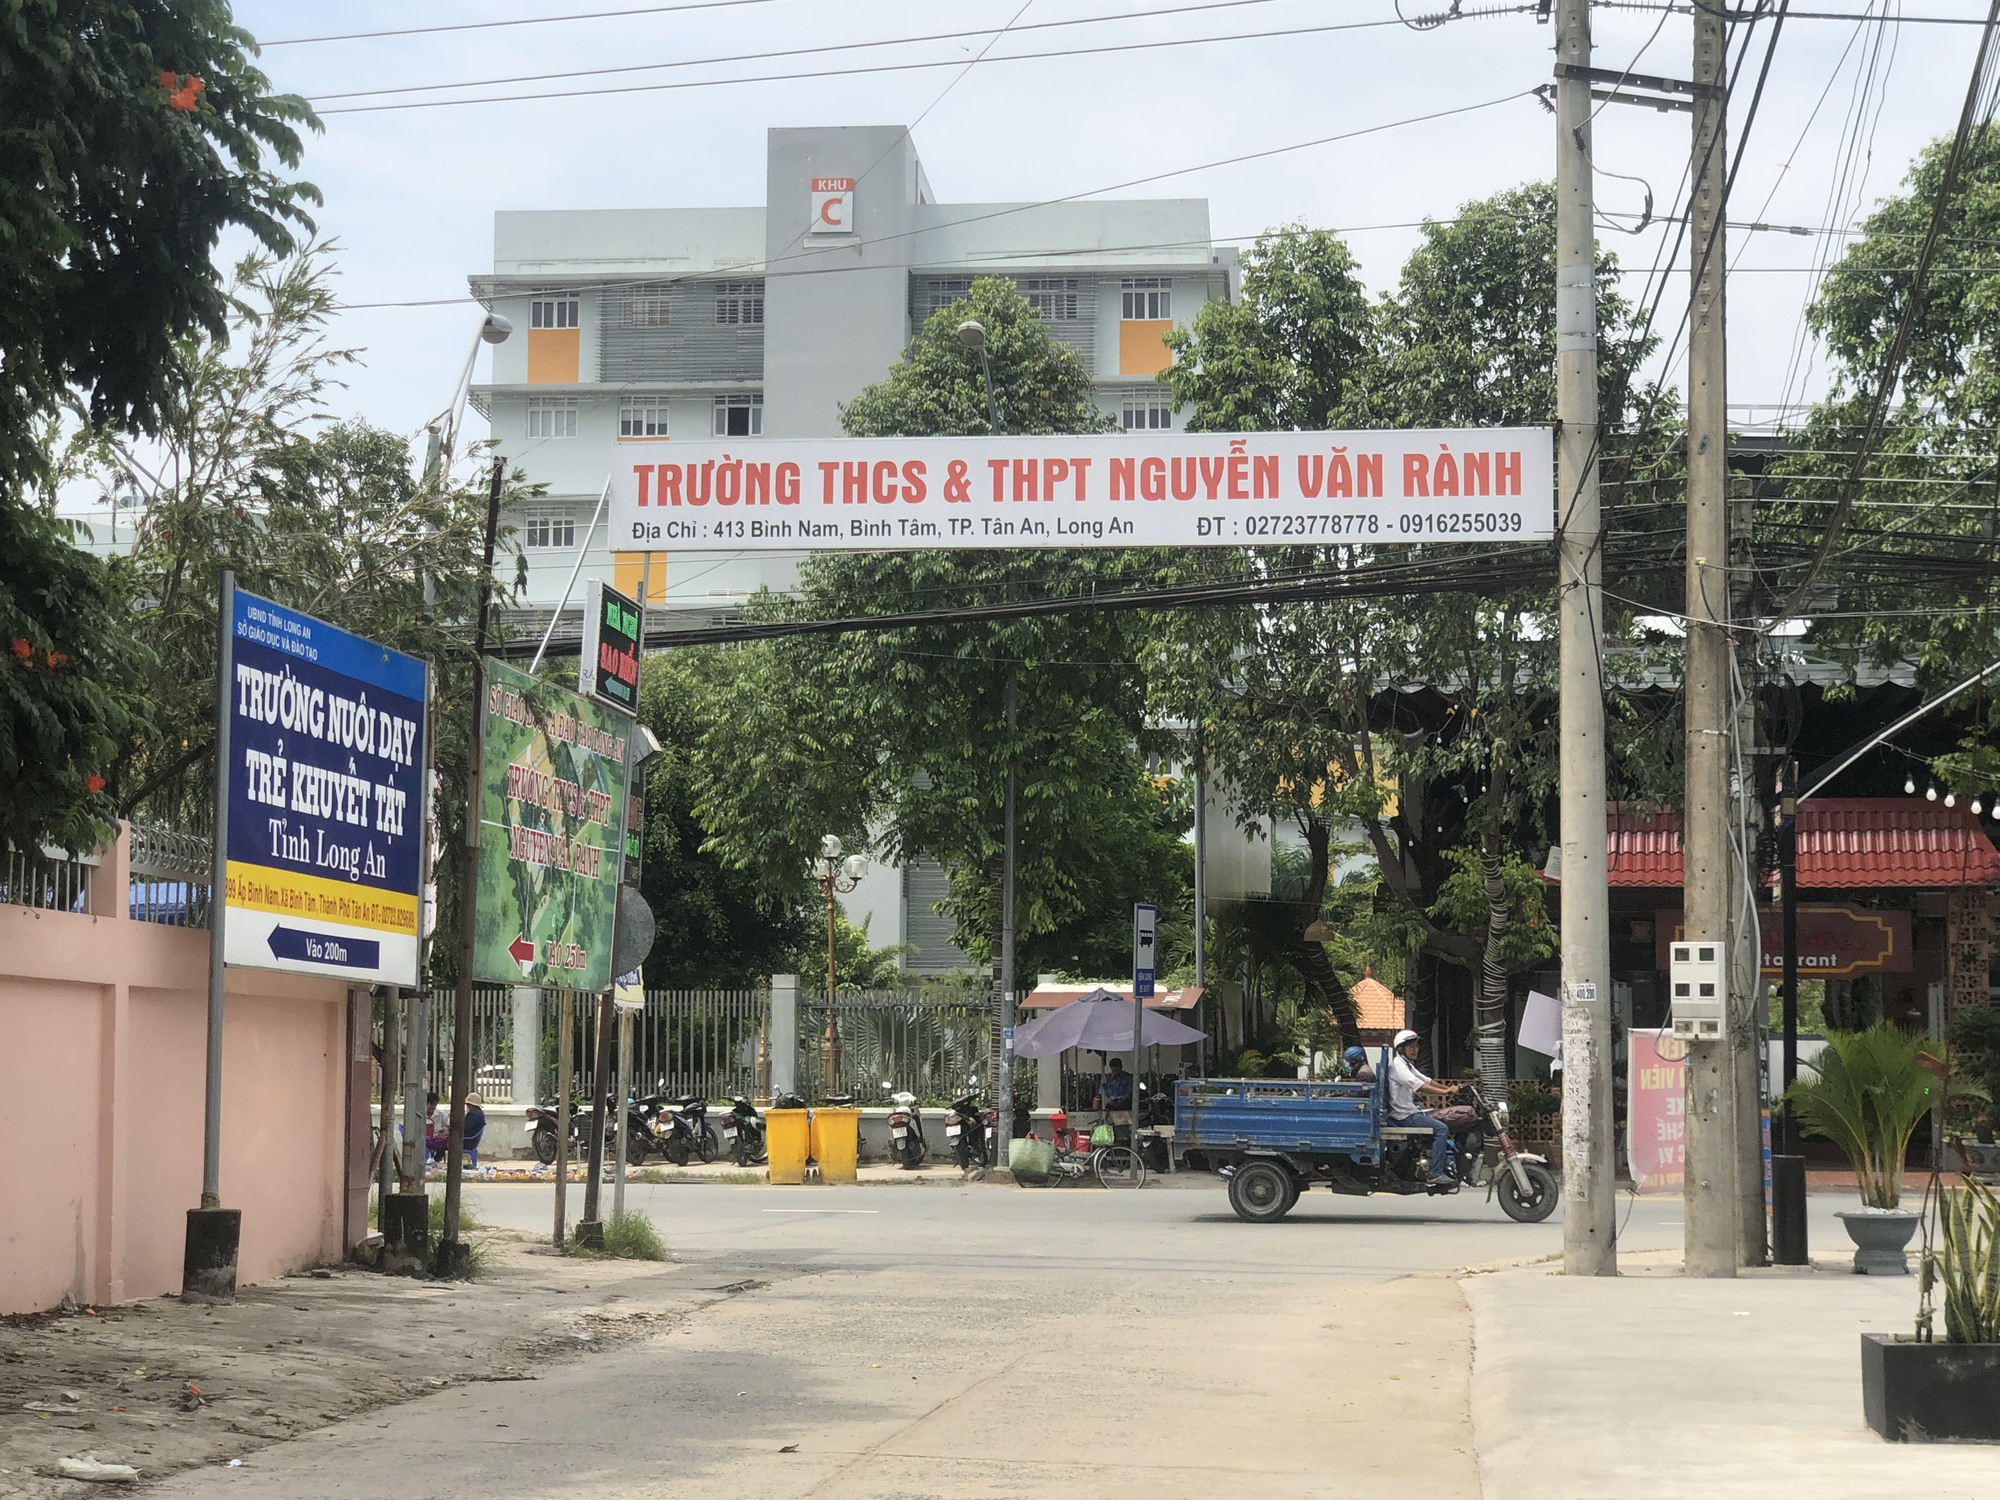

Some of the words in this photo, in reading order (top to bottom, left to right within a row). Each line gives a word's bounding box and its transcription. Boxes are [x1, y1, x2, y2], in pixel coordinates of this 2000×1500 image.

[818, 179, 847, 191] KHU
[821, 198, 843, 226] C
[633, 454, 800, 507] TRƯỜNG
[818, 460, 927, 505] THCS
[943, 459, 972, 503] &
[987, 457, 1092, 502] THPT
[1109, 439, 1280, 501] NGUYỄN
[1297, 445, 1384, 498] VĂN
[1403, 443, 1522, 497] RÀNH
[632, 522, 660, 543] Địa
[667, 520, 697, 538] Chỉ
[714, 520, 745, 538] 413
[751, 520, 791, 538] Bình
[799, 520, 844, 540] Nam,
[850, 519, 891, 537] Bình
[898, 518, 942, 539] Tâm,
[948, 518, 974, 536] TP.
[981, 517, 1014, 536] Tân
[1019, 517, 1050, 538] An,
[1057, 517, 1103, 539] Long
[1108, 516, 1134, 535] An
[1197, 516, 1226, 537] ĐT
[1245, 514, 1379, 536] 02723778778
[1399, 512, 1522, 535] 0916255039
[247, 605, 267, 624] UBND
[284, 618, 301, 636] LONG
[303, 626, 312, 640] AN
[237, 618, 248, 636] SỞ
[248, 625, 266, 642] GIÁO
[266, 631, 280, 649] DỤC
[282, 635, 290, 651] VÀ
[291, 639, 305, 656] ĐÀO
[306, 645, 318, 661] TẠO
[237, 664, 325, 739] TRƯỜNG
[327, 692, 376, 755] NUÔI
[378, 711, 416, 772] DẠY
[246, 739, 287, 808] TRẺ
[291, 757, 371, 827] KHUYẾT
[375, 774, 406, 845] TẬT
[588, 789, 611, 826] THPT
[269, 818, 310, 863] Tỉnh
[316, 829, 361, 882] Long
[364, 839, 386, 879] An
[306, 937, 322, 958] Vào
[324, 942, 347, 962] 200m
[564, 942, 586, 970] 250m
[1760, 953, 1837, 966] tarant
